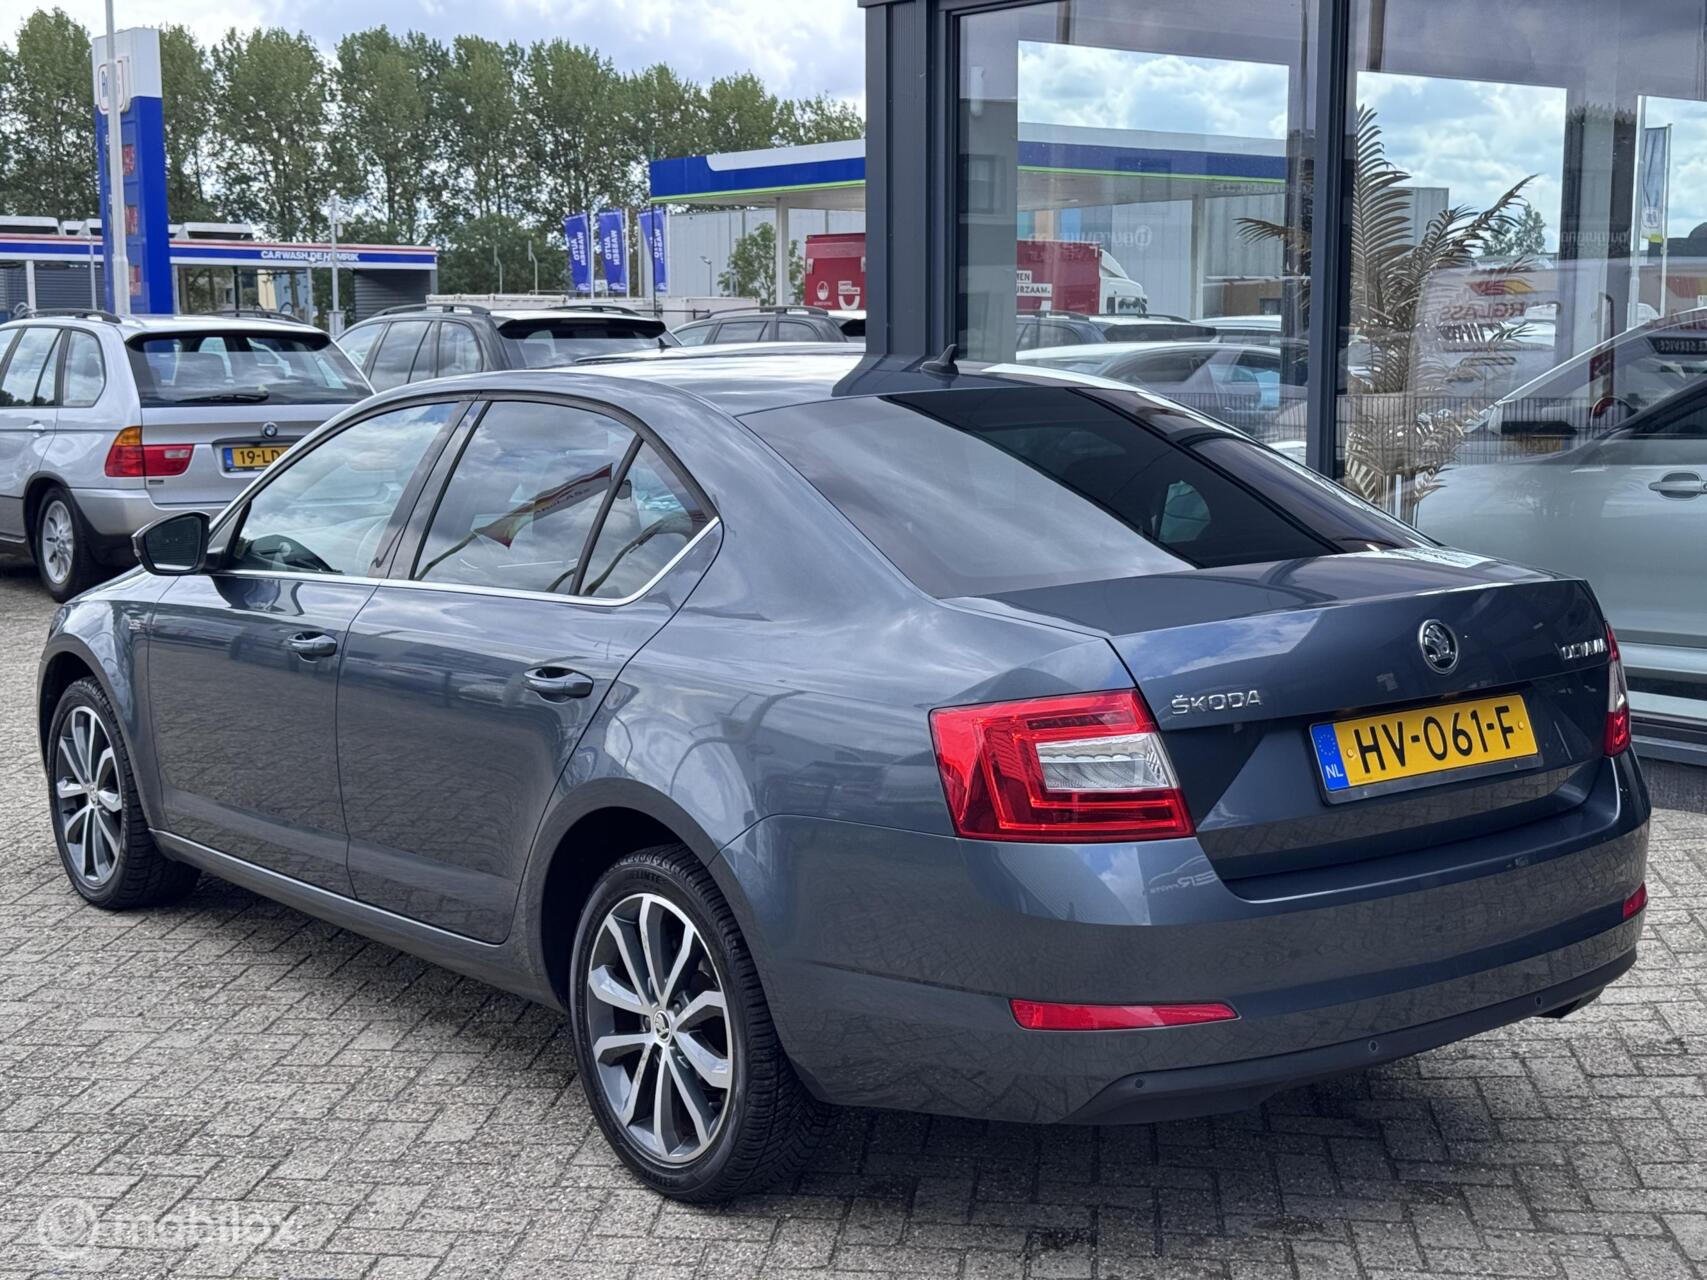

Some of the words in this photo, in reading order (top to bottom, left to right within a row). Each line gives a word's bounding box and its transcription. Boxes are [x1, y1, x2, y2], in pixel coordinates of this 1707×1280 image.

[260, 250, 308, 260] CARWASH
[1171, 690, 1262, 714] ŠKODA
[1353, 705, 1515, 773] HV-061-F
[1325, 764, 1344, 779] NL
